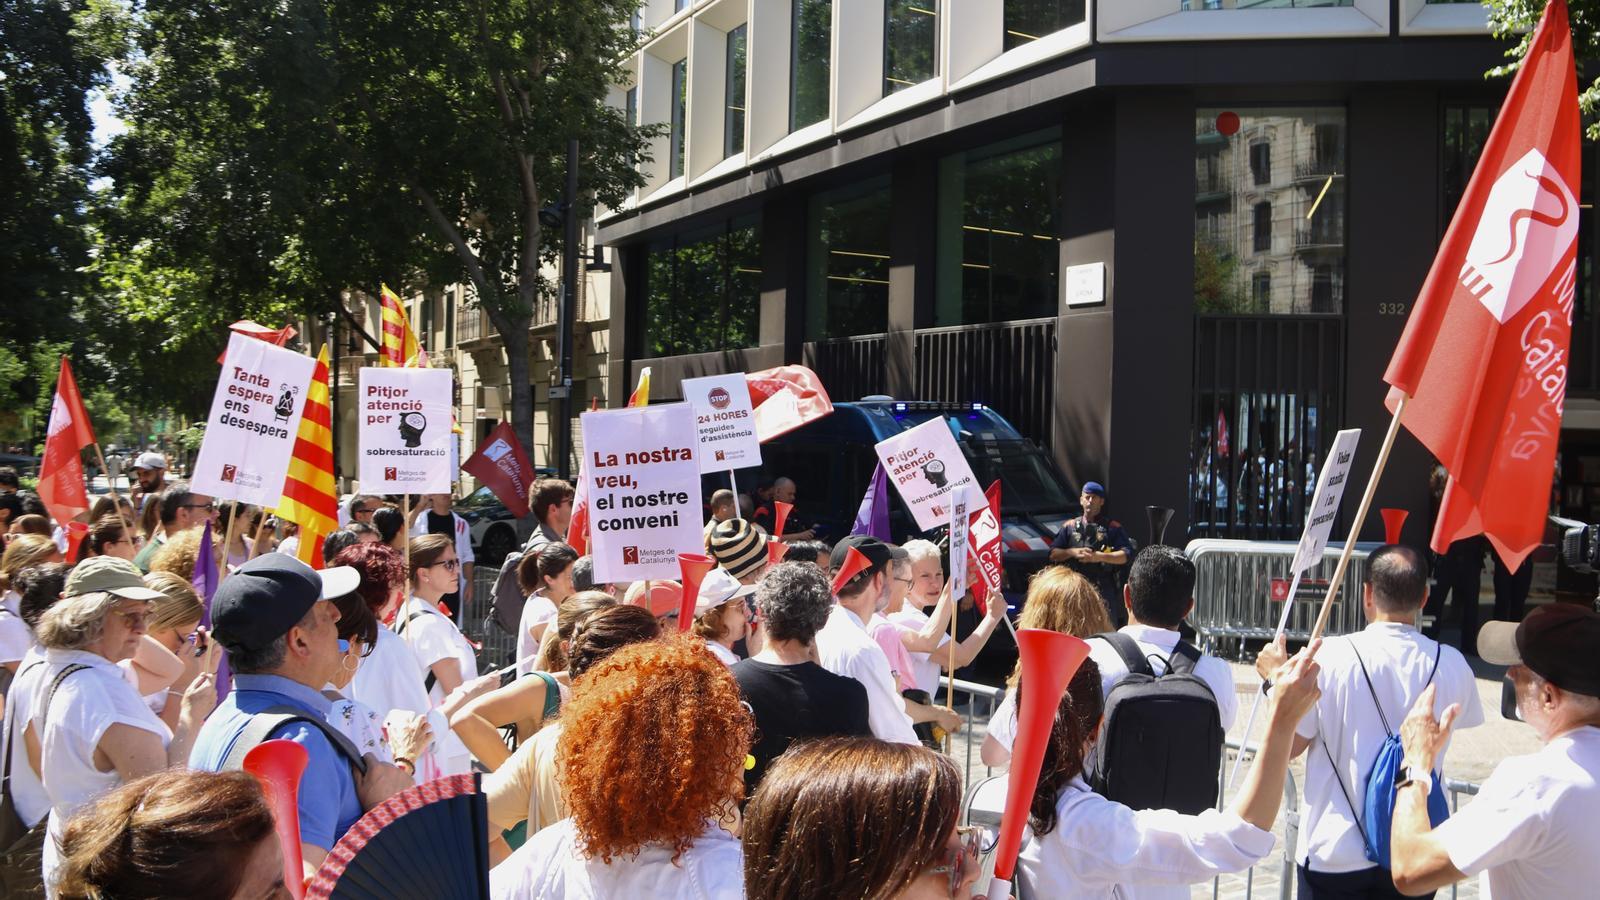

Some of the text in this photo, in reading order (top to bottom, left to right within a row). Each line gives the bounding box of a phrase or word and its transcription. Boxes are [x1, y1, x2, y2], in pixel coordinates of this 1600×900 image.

[1379, 302, 1405, 315] 332
[233, 366, 270, 388] Tanta
[228, 384, 275, 405] espera
[367, 385, 409, 399] Pitjor
[711, 395, 728, 403] STOP
[224, 399, 250, 414] ens
[367, 399, 423, 411] atenció
[367, 414, 392, 425] per
[697, 409, 748, 424] 24 HORES
[220, 412, 288, 439] desespera
[699, 423, 735, 434] seguides
[700, 429, 752, 443] d'assistència
[366, 447, 446, 456] sobresaturació
[594, 446, 692, 468] La nostra
[886, 446, 919, 466] Pitjor
[892, 450, 935, 476] atenció
[595, 474, 638, 490] veu,
[898, 470, 917, 485] per
[911, 475, 971, 505] sobresaturació
[596, 490, 688, 510] el nostre
[597, 510, 678, 531] conveni
[640, 550, 664, 558] Metges
[640, 556, 676, 565] Catalunya
